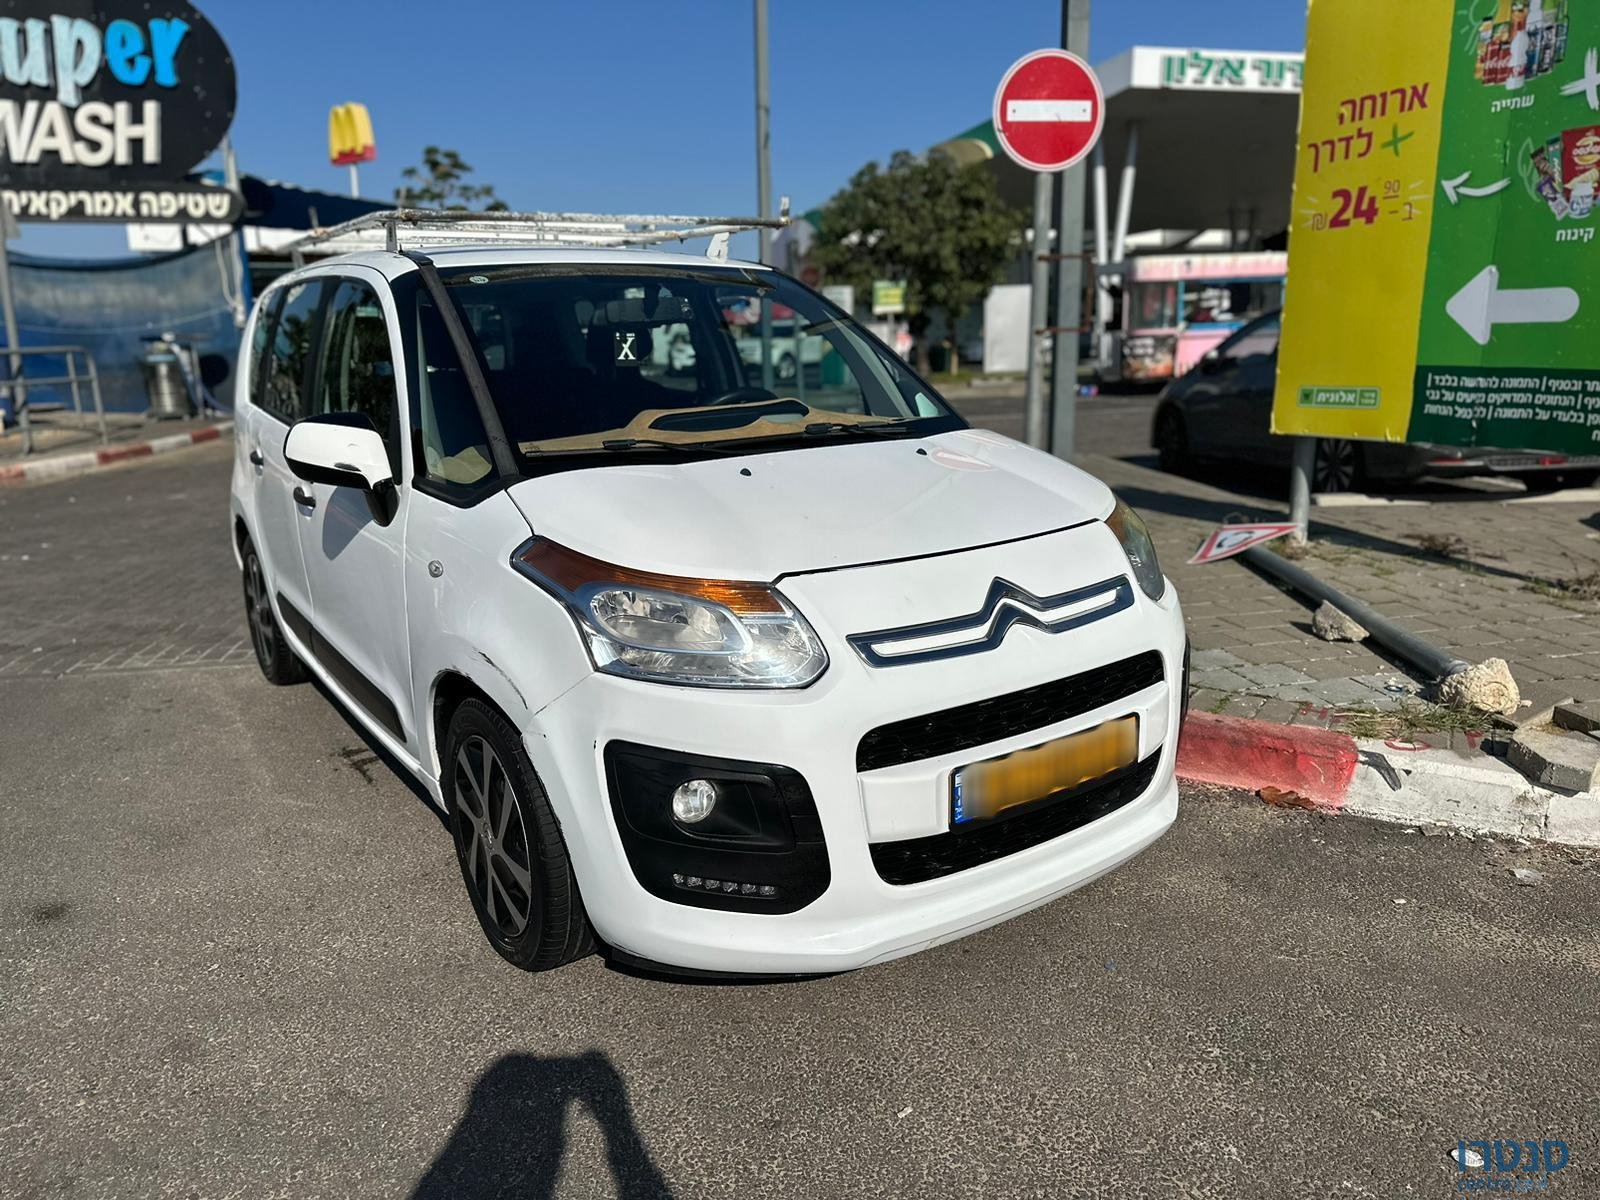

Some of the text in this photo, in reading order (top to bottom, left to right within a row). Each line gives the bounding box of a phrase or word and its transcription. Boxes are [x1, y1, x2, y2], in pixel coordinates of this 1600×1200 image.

[0, 15, 189, 107] uper
[1163, 52, 1245, 85] אלון
[1338, 82, 1429, 125] ארוחה
[1491, 95, 1534, 113] שתייה
[1307, 127, 1373, 173] לדרך
[139, 191, 230, 218] שטיפה
[1329, 186, 1379, 229] 24
[1555, 227, 1594, 243] קינוח
[1433, 374, 1458, 387] בלבד
[1500, 377, 1540, 389] התמונה
[1441, 388, 1455, 401] על
[1535, 407, 1551, 420] על
[1552, 410, 1585, 423] בלעדי
